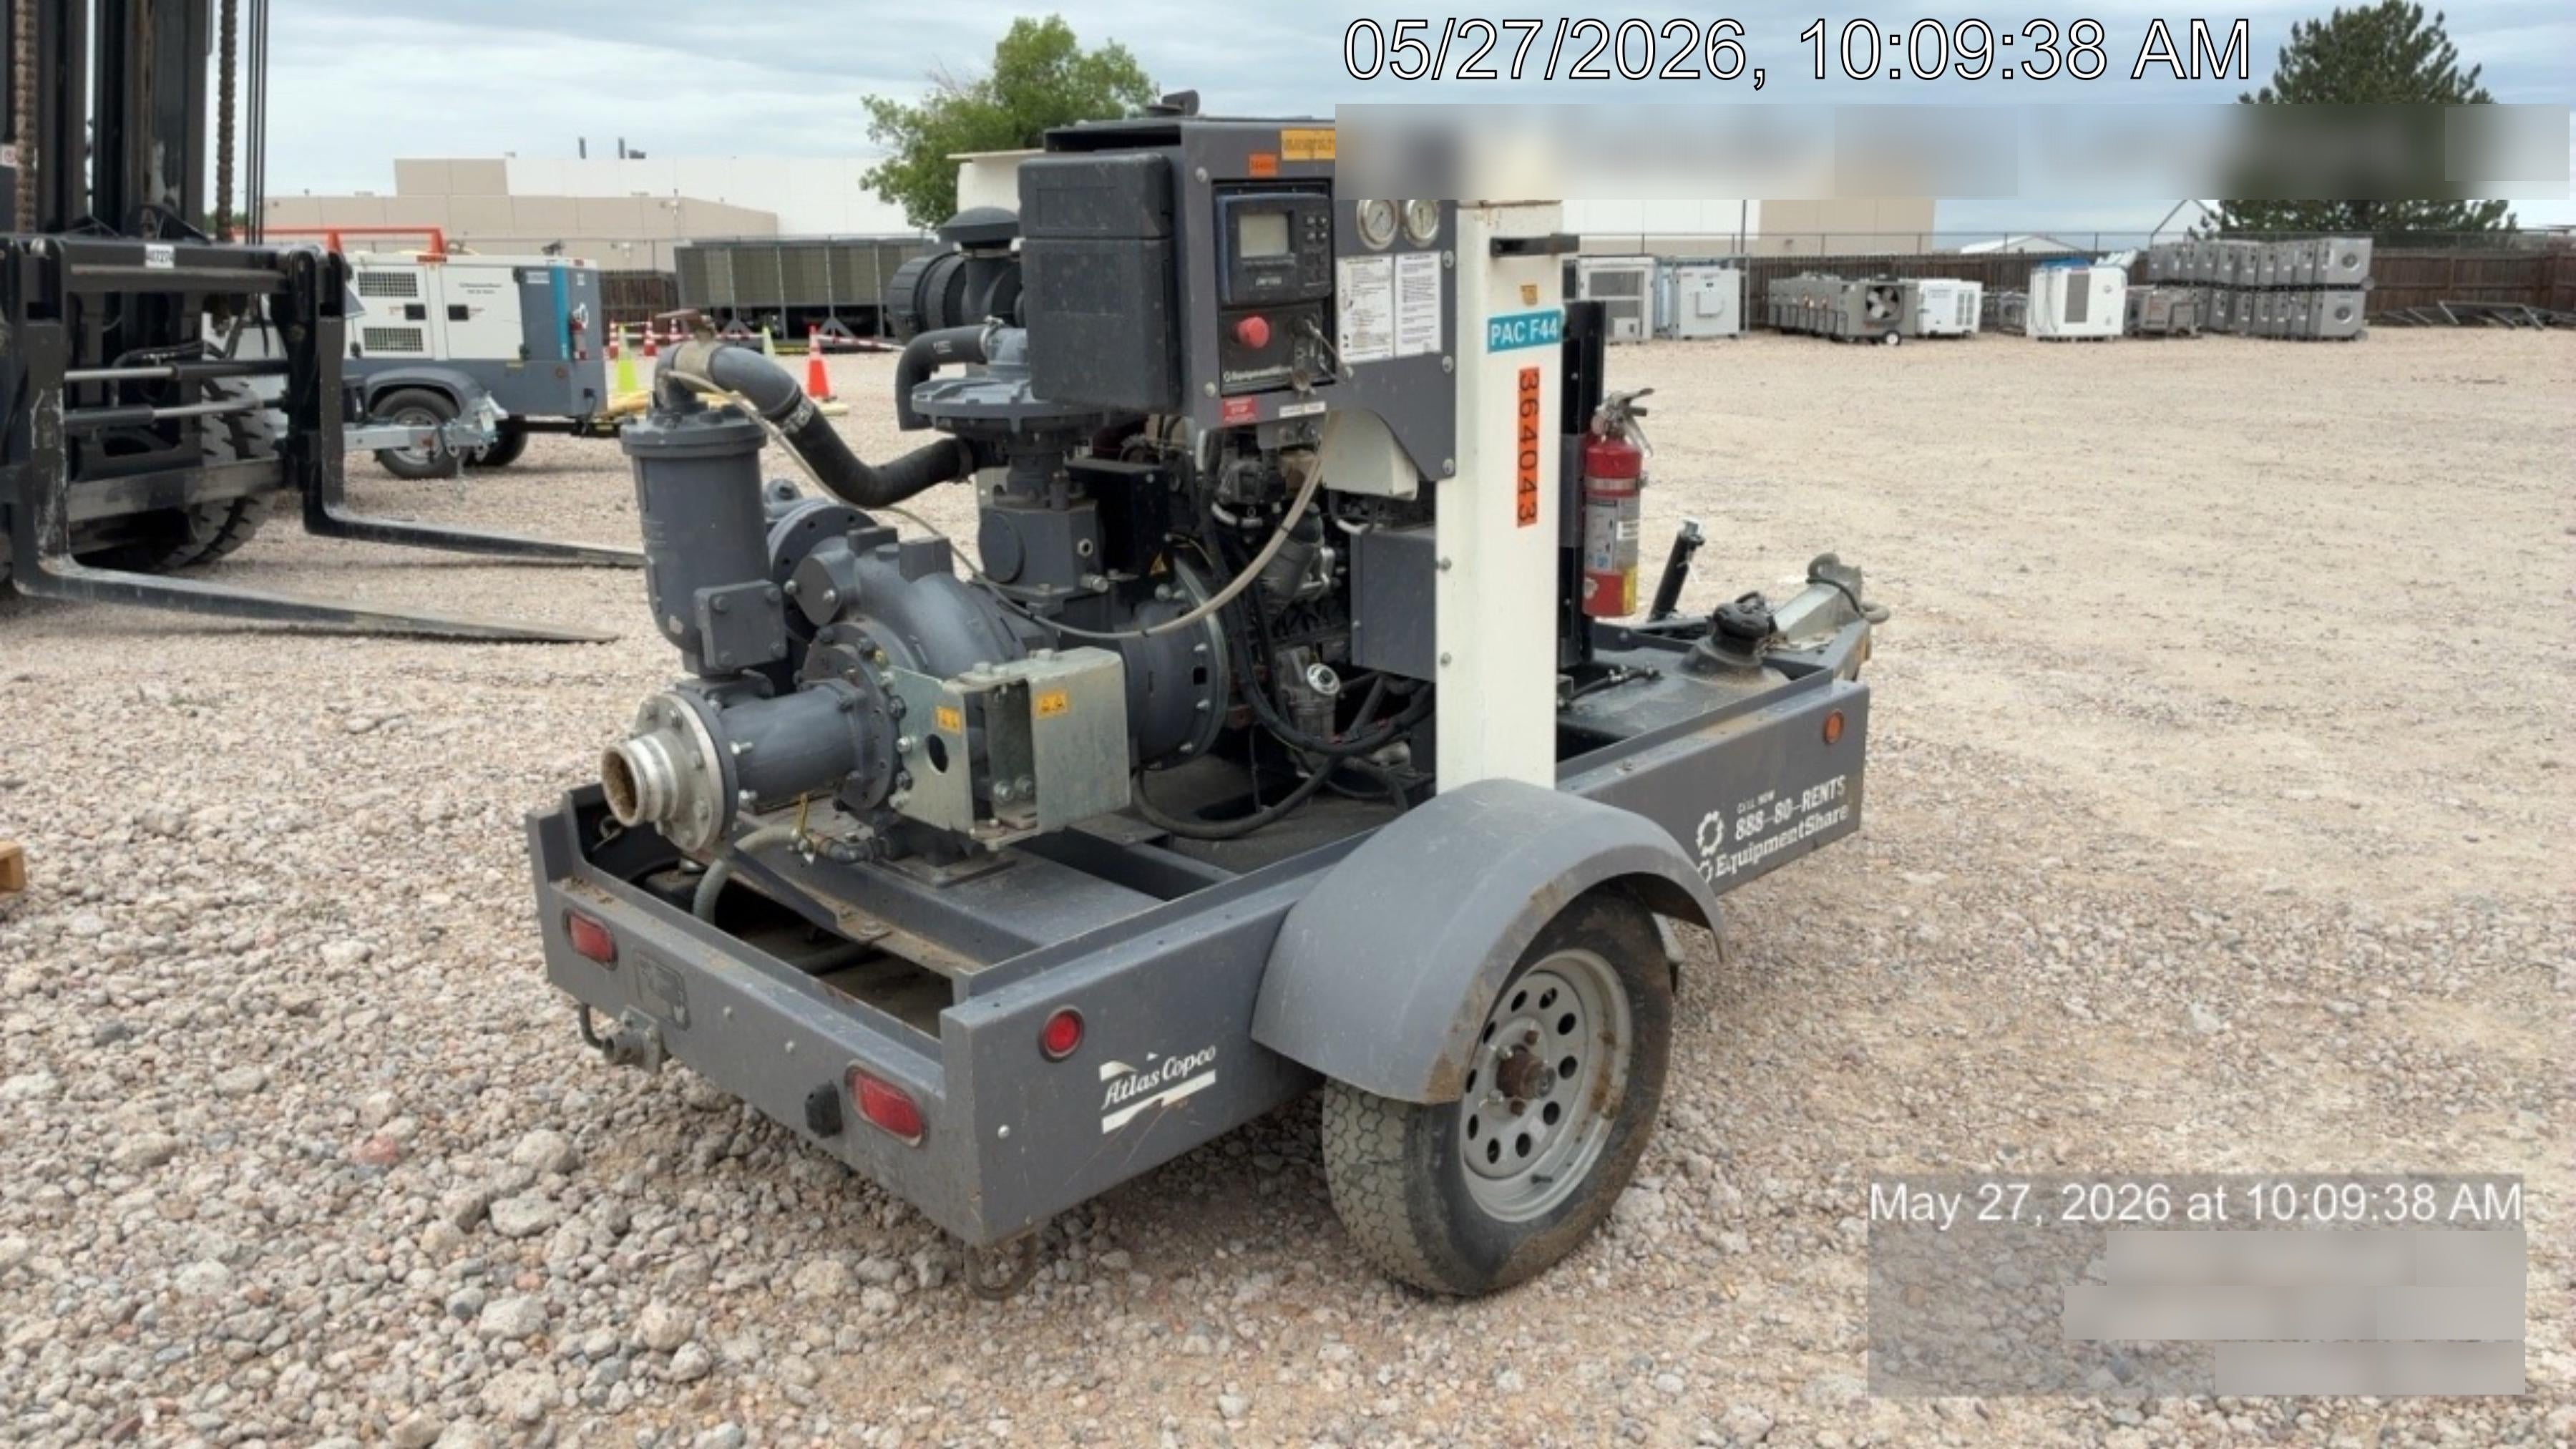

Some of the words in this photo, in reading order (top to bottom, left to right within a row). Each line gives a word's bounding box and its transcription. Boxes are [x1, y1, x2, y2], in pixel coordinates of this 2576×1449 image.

[1491, 320, 1526, 346] PAC
[1529, 316, 1557, 342] F44
[1518, 370, 1538, 522] 364043
[1715, 804, 1849, 877] EquipmentShare
[1101, 1071, 1160, 1111] Atlas
[1161, 1044, 1216, 1081] Copco
